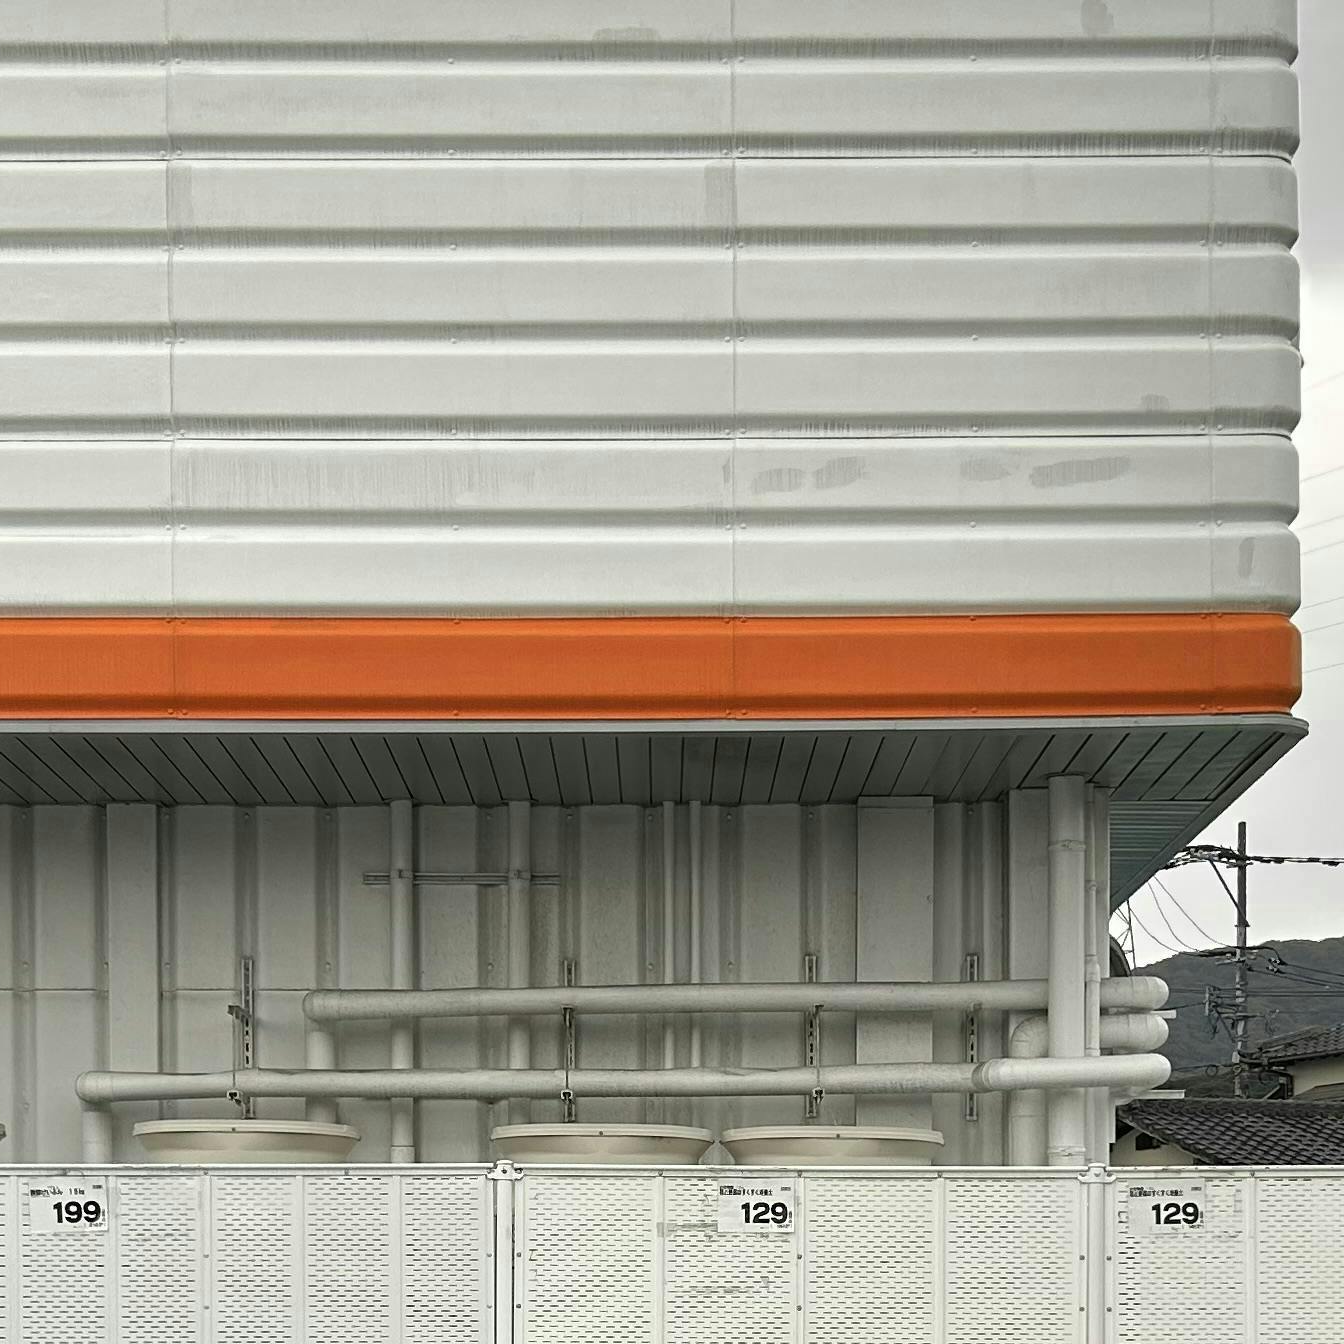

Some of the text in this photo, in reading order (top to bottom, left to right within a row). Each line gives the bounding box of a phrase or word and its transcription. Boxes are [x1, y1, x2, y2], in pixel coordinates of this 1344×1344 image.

[53, 1200, 101, 1223] 199
[741, 1202, 788, 1224] 129
[1152, 1202, 1199, 1224] 129
